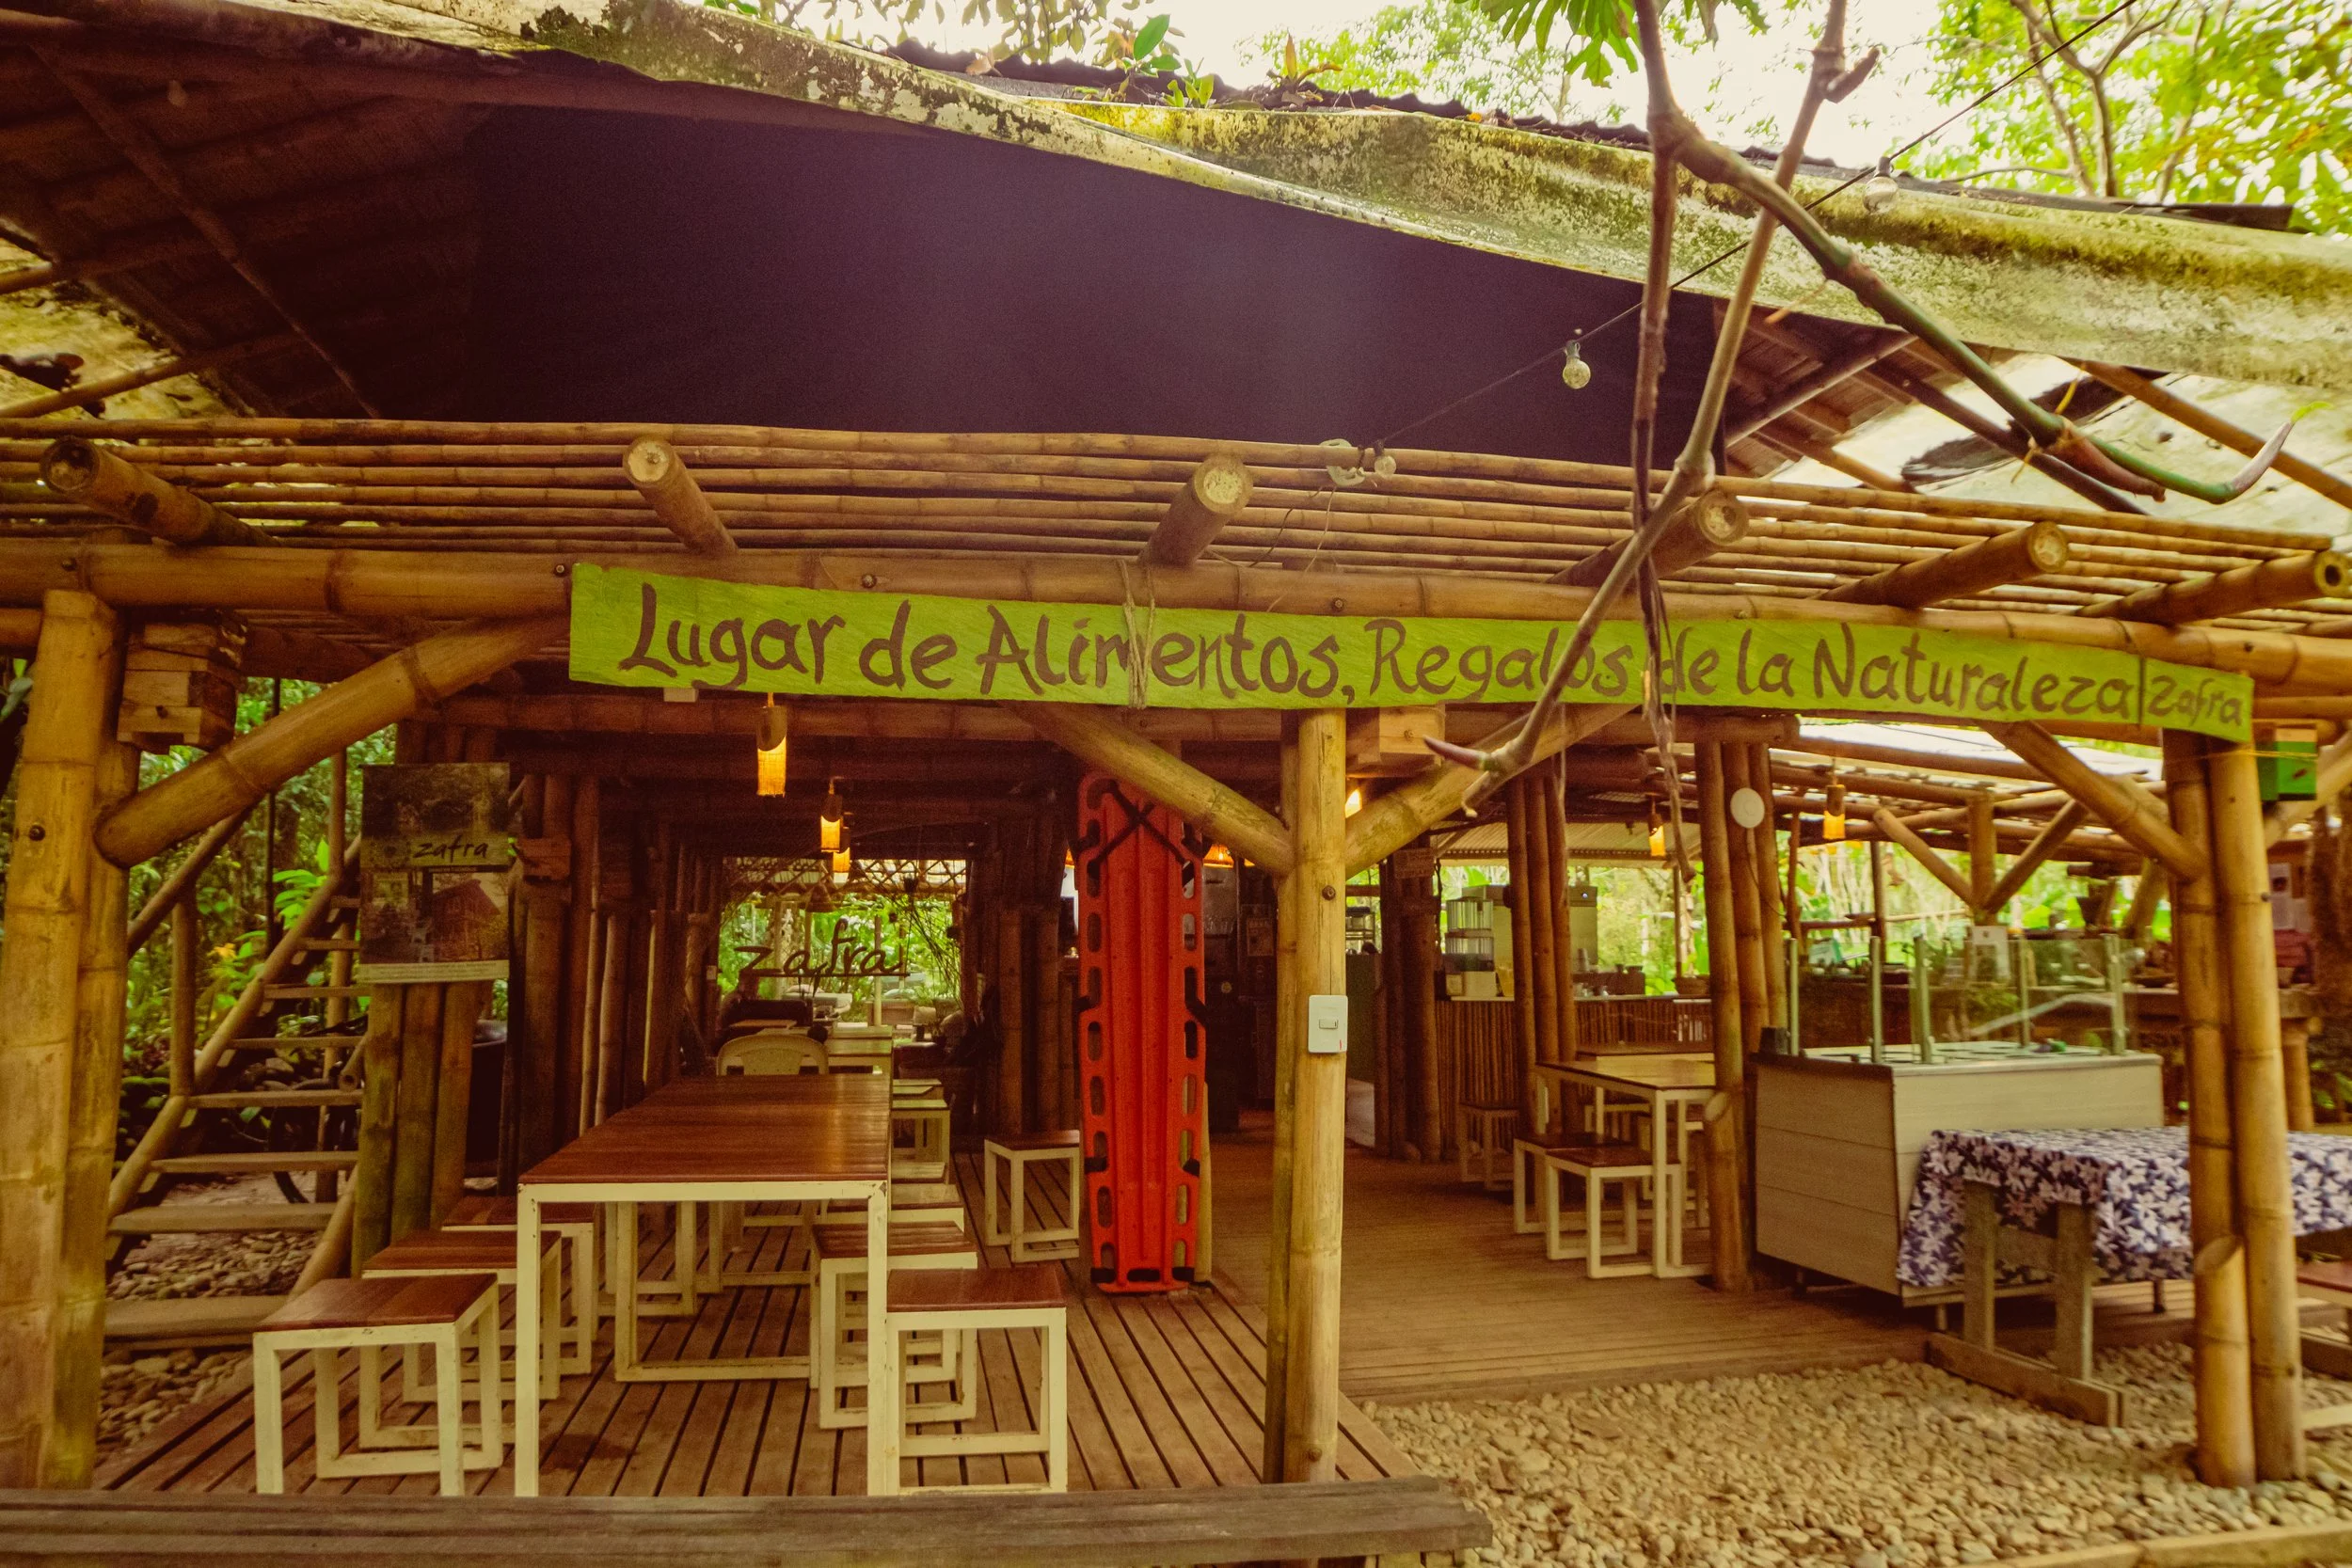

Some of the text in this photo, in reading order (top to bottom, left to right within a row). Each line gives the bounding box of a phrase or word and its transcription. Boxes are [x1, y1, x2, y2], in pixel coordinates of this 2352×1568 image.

[618, 583, 846, 691] Lugar
[858, 599, 959, 691] de
[1364, 617, 1634, 704] Regalos
[1659, 626, 1720, 695] de
[1736, 628, 1799, 696] la
[1814, 622, 2133, 719] Naturaleza
